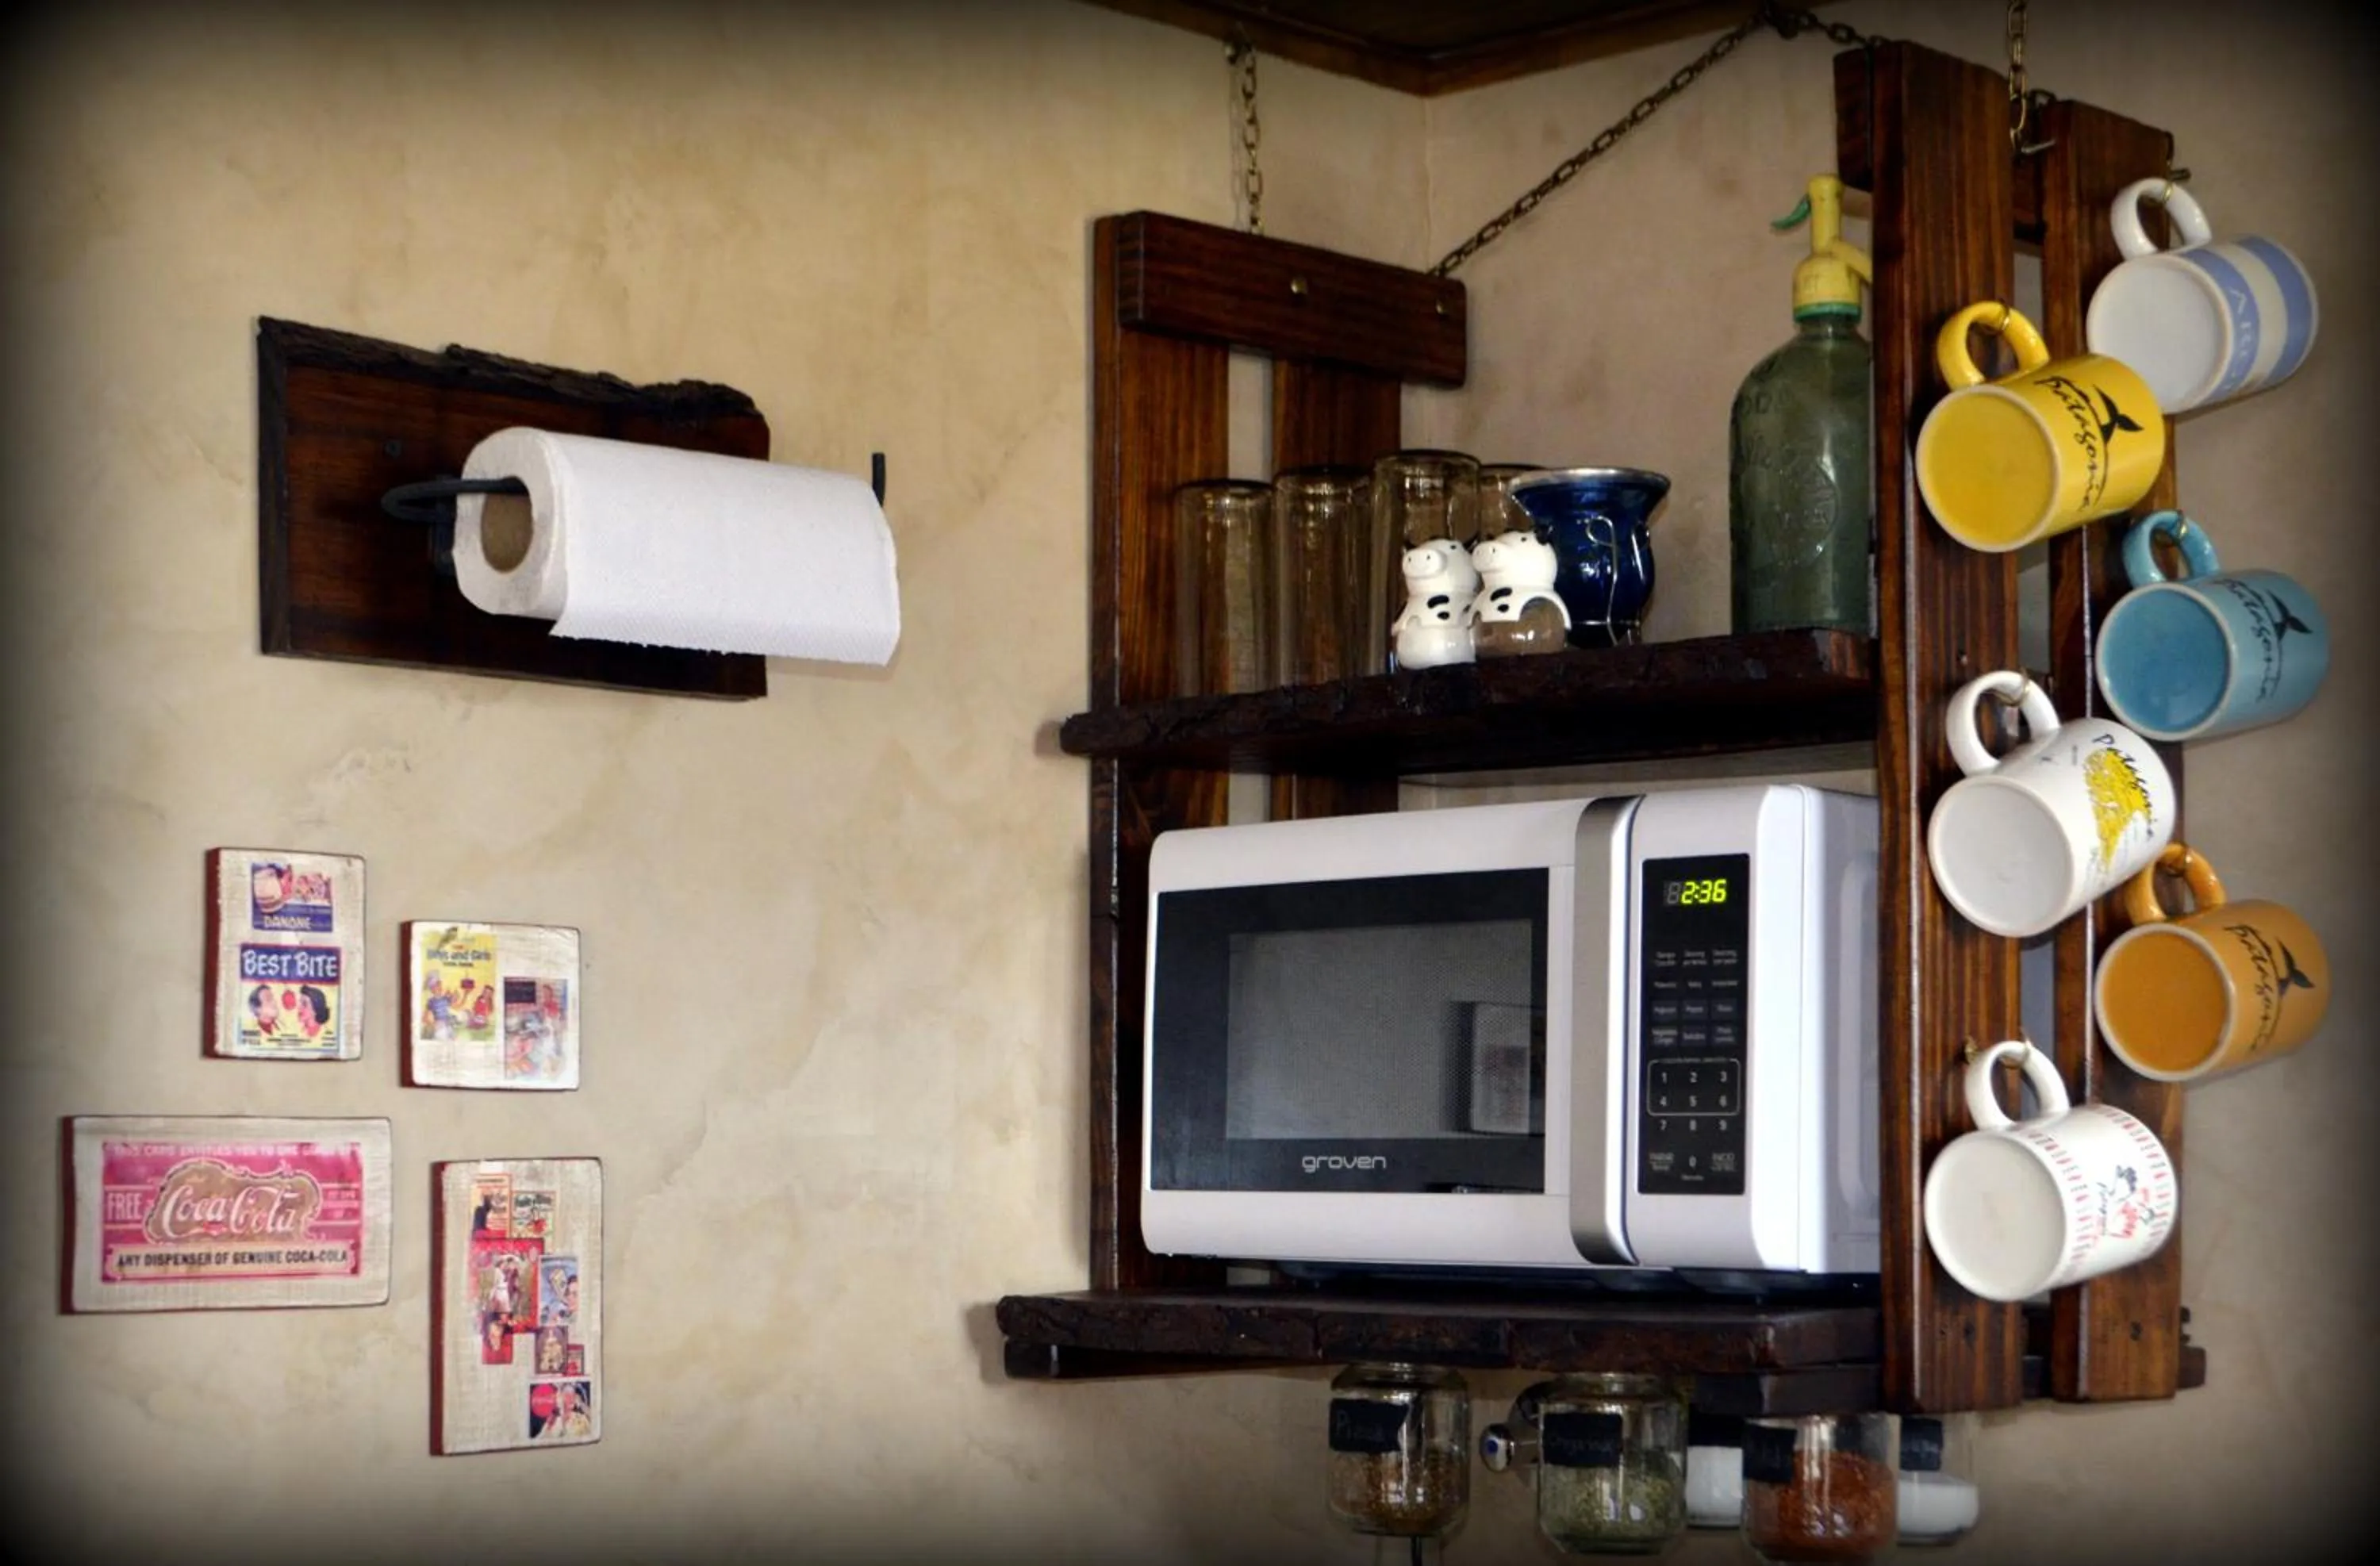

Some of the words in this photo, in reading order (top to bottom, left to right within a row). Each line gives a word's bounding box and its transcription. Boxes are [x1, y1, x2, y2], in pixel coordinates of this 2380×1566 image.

[1680, 879, 1727, 904] 2:36
[263, 915, 312, 930] DANONE
[243, 949, 292, 977] BEST
[294, 951, 337, 977] BITE
[1661, 1072, 1668, 1083] 1
[1689, 1072, 1698, 1084] 2
[1719, 1071, 1728, 1083] 3
[1660, 1096, 1668, 1107] 4
[1689, 1096, 1698, 1107] 5
[1719, 1096, 1728, 1107] 6
[1660, 1119, 1668, 1130] 7
[1718, 1119, 1728, 1130] 9
[1302, 1155, 1387, 1173] groven
[108, 1192, 143, 1220] FREE
[117, 1253, 141, 1268] ANY
[144, 1252, 212, 1267] DISPENSER
[214, 1251, 229, 1265] OF
[232, 1250, 283, 1265] GENUINE
[286, 1249, 348, 1264] COCA-COLA
